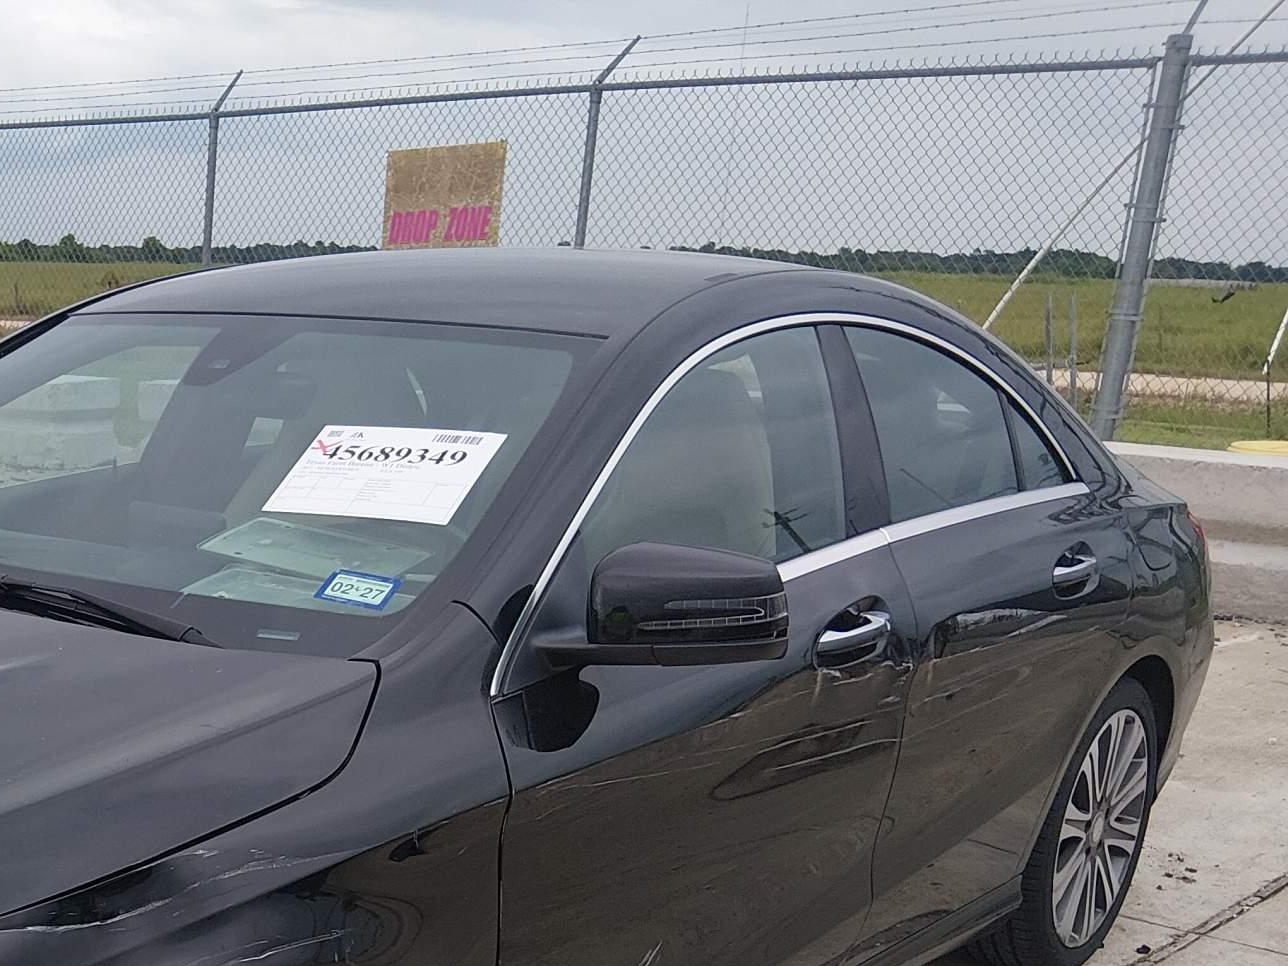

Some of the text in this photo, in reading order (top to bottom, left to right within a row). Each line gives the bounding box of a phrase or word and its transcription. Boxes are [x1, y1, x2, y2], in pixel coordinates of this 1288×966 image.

[387, 206, 492, 245] DROP ZONE
[323, 444, 468, 466] 45689349
